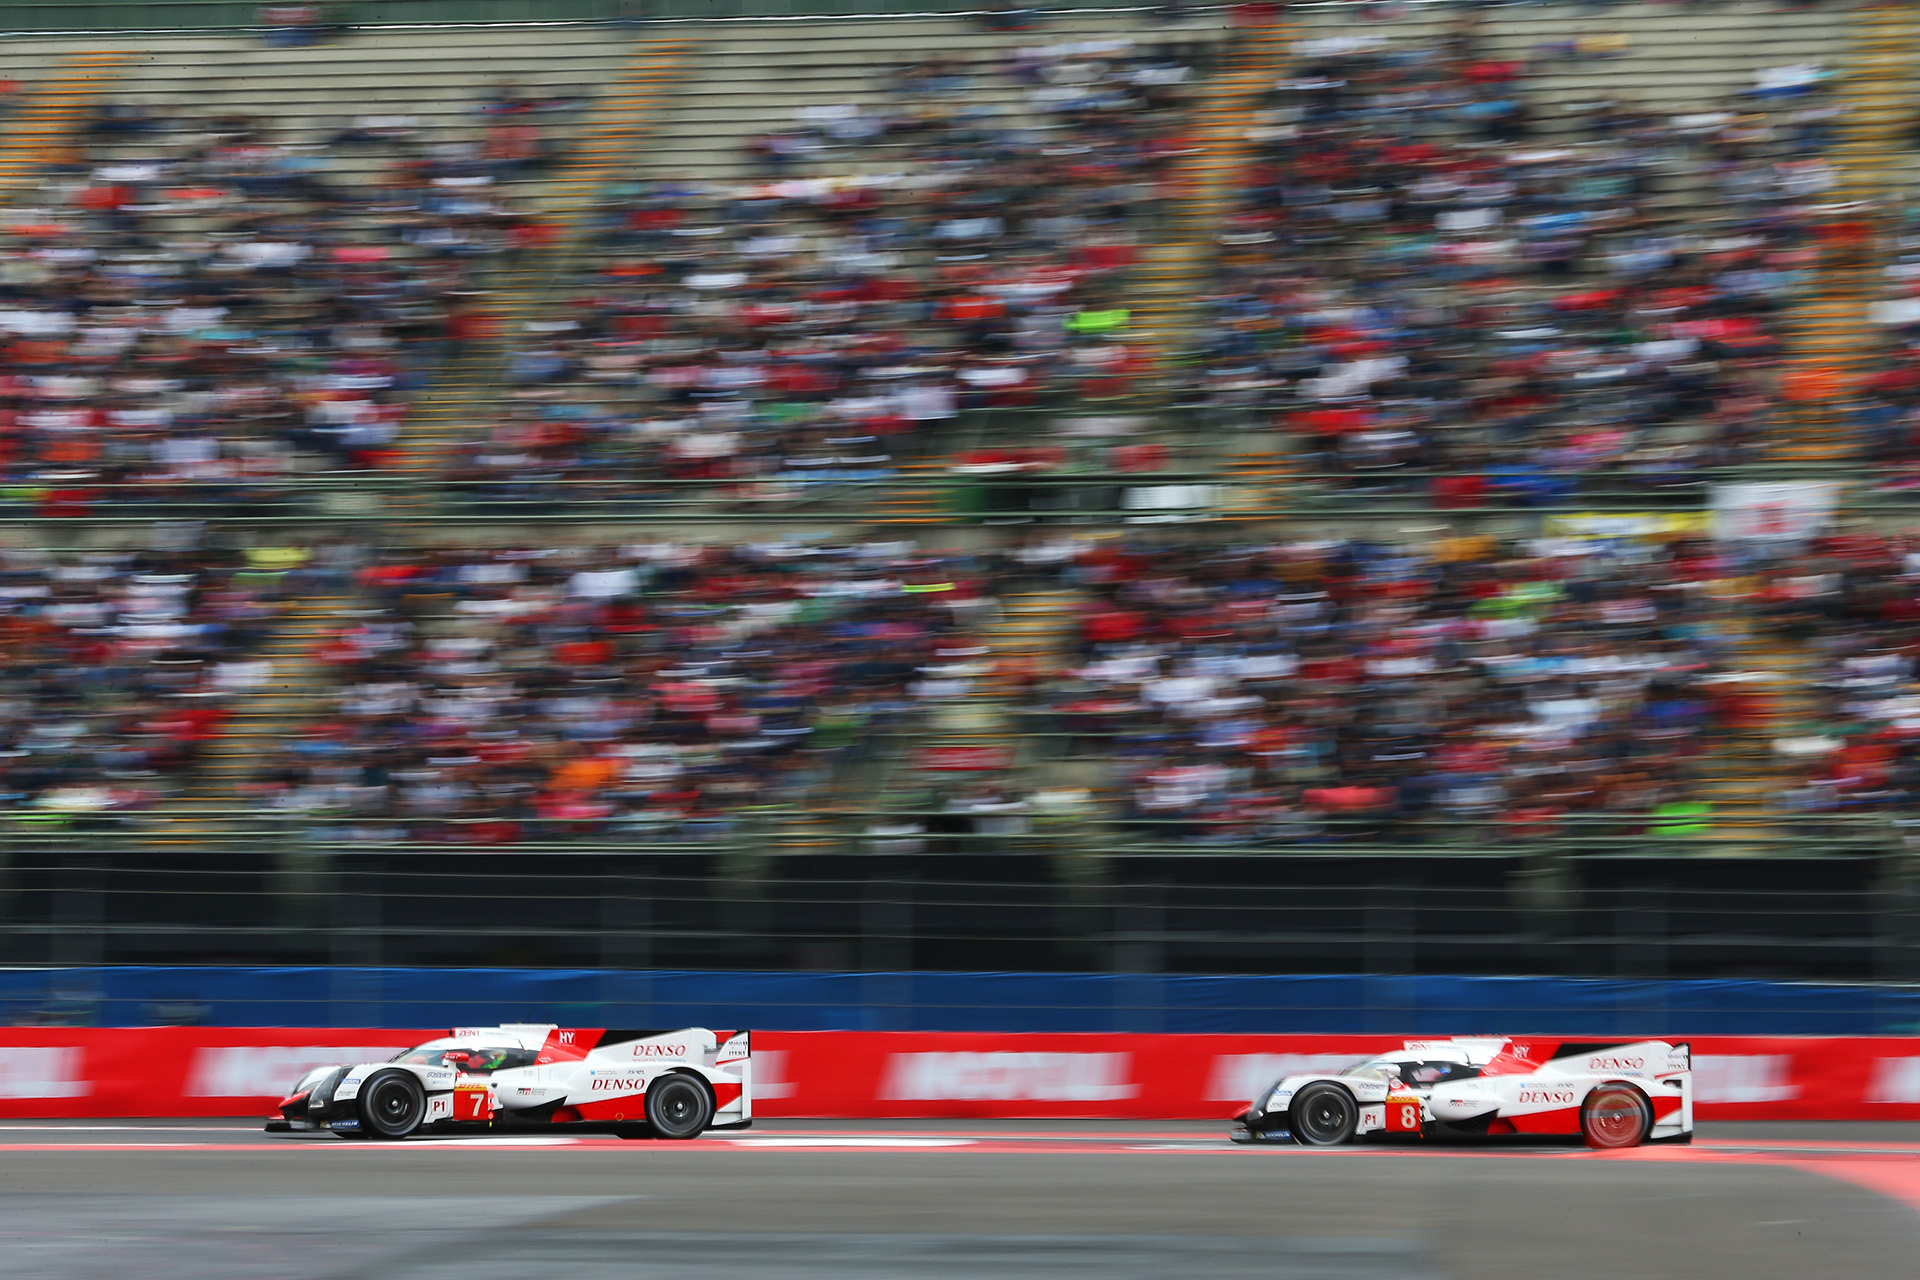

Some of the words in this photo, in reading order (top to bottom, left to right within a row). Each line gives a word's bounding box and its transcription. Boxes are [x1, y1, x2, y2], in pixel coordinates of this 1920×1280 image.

[559, 1031, 575, 1044] HY
[633, 1045, 686, 1056] DENSO
[1589, 1057, 1645, 1070] DENSO
[591, 1079, 646, 1090] DENSO
[1519, 1091, 1575, 1104] DENSO
[433, 1101, 446, 1112] P1
[470, 1093, 485, 1117] 7
[1364, 1113, 1377, 1125] P1
[1401, 1105, 1417, 1129] 8
